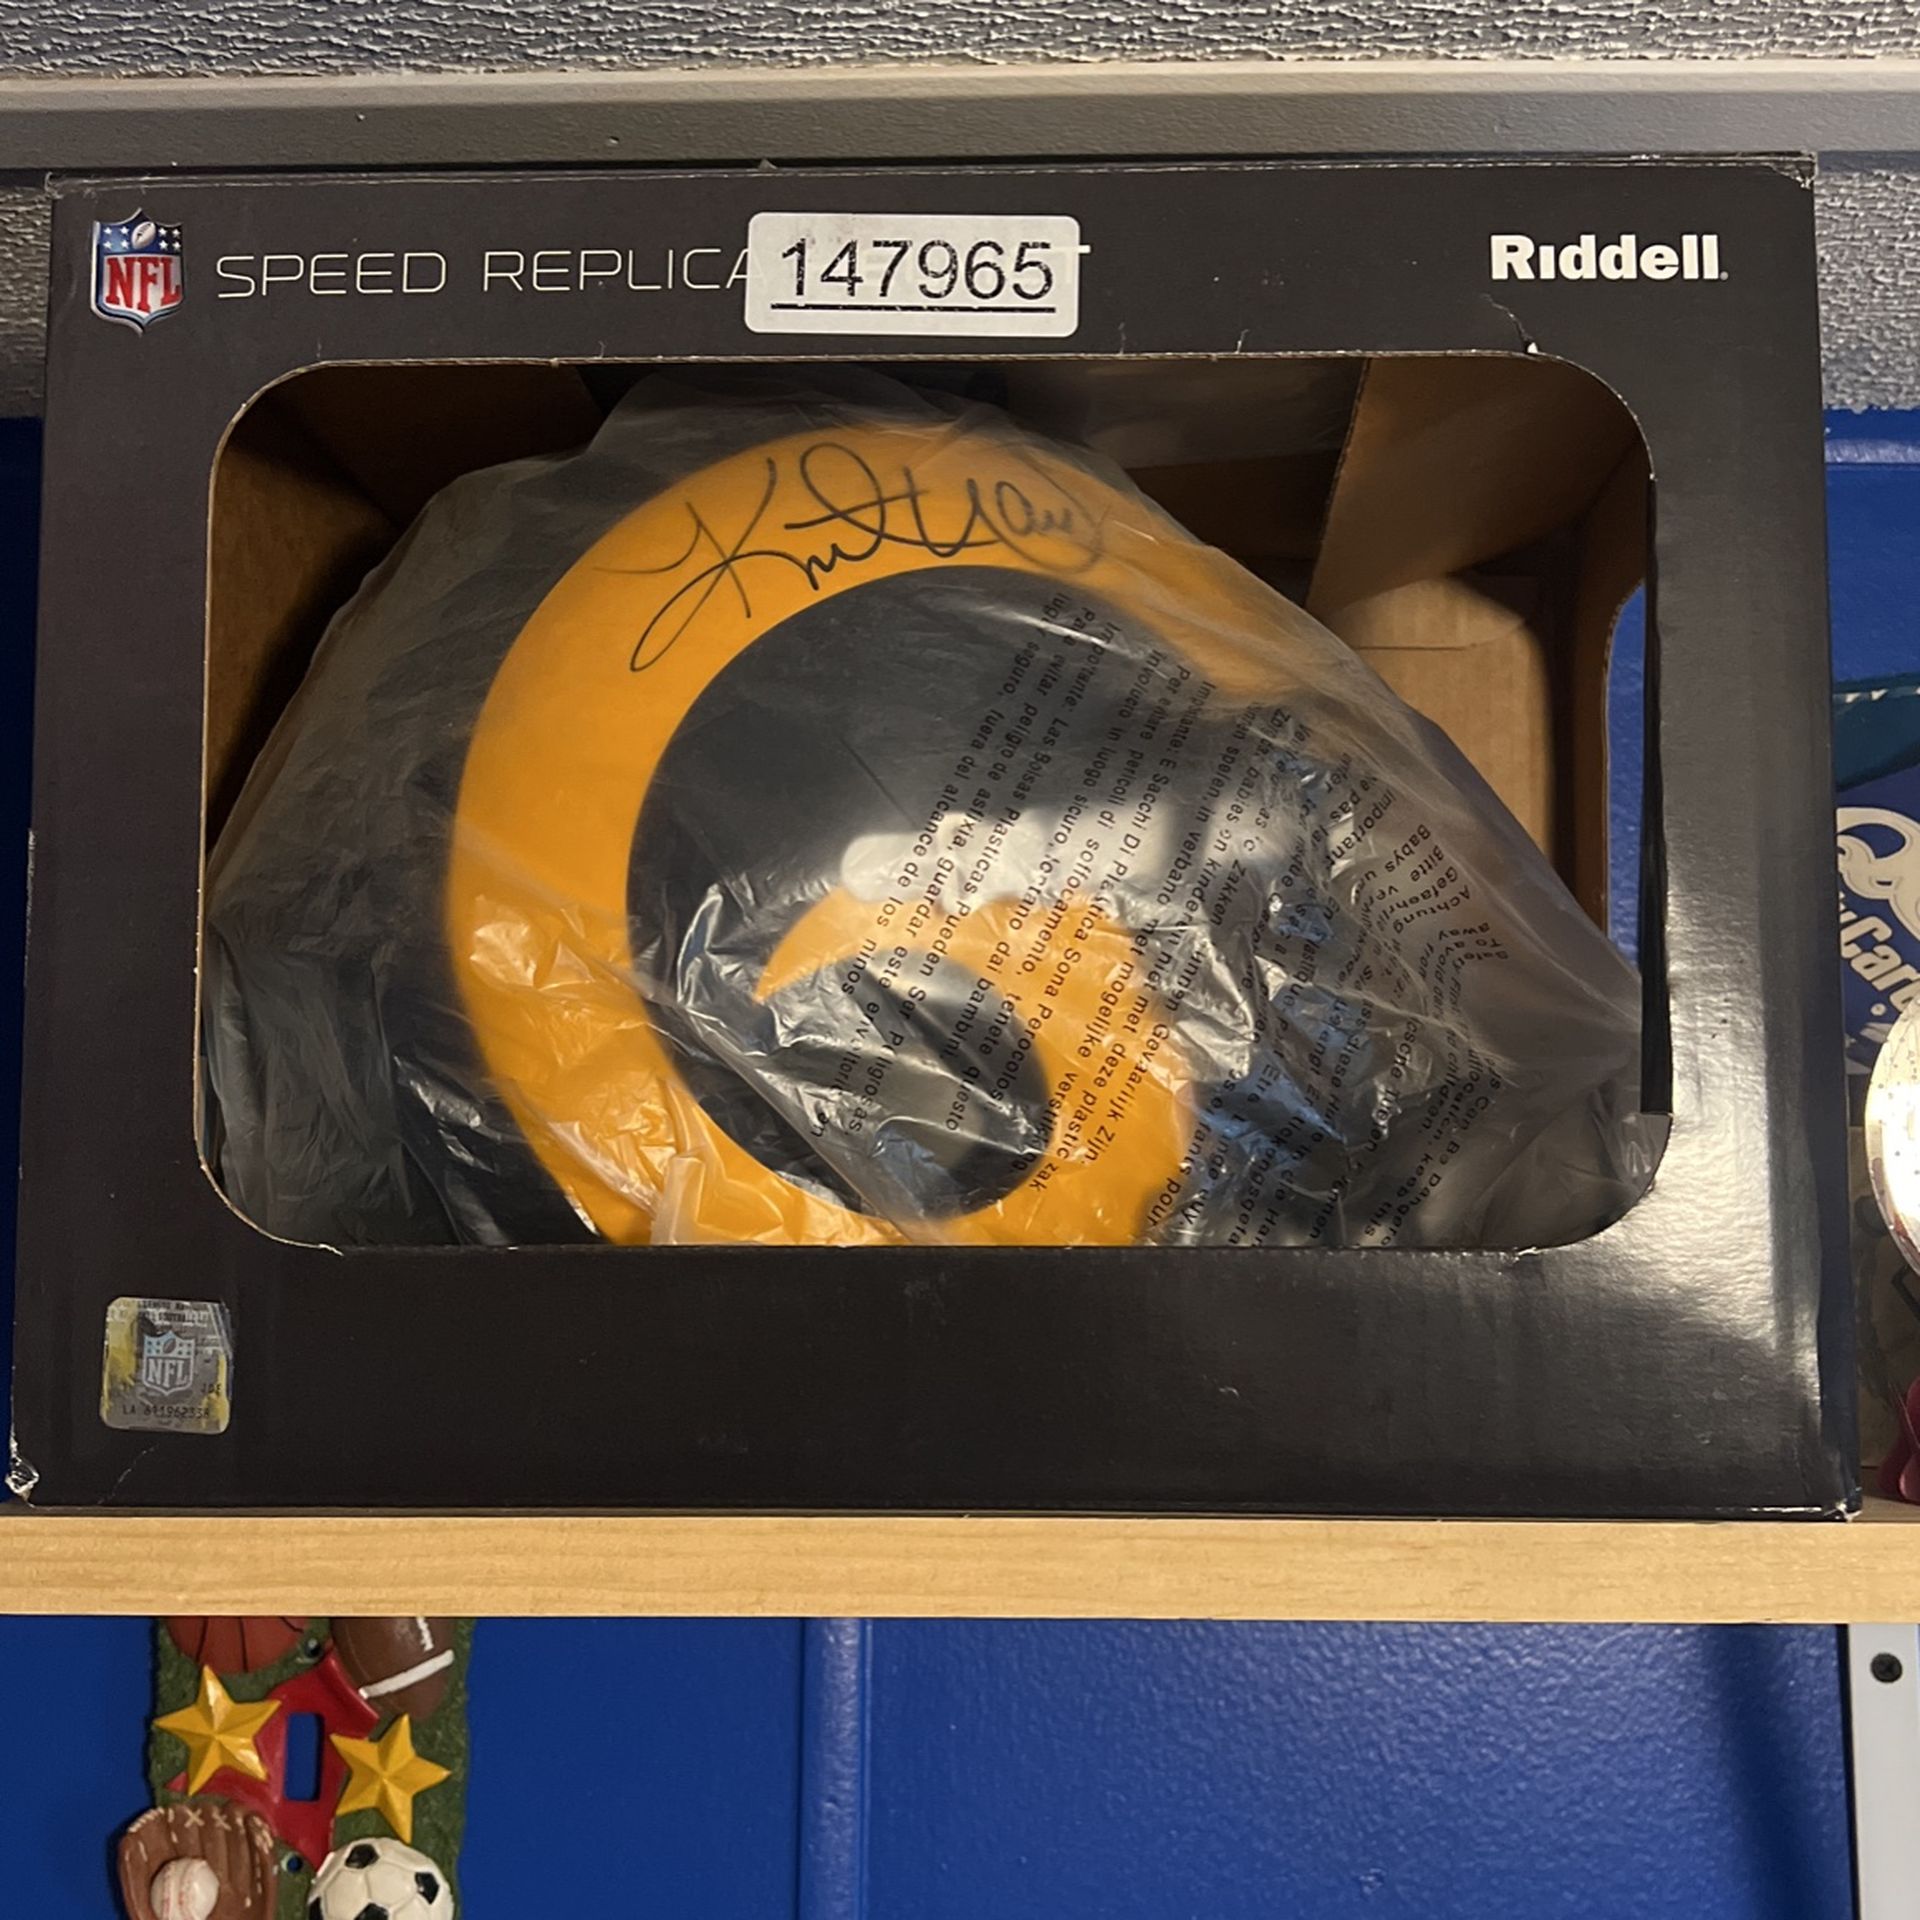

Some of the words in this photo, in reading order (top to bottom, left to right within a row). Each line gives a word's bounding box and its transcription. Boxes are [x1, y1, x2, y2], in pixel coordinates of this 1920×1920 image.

[104, 256, 182, 311] NFL
[216, 251, 447, 299] SPEED
[780, 238, 1056, 300] 147965
[996, 637, 1041, 702] seguro,
[1163, 664, 1191, 696] Per
[969, 707, 1006, 754] fuera
[996, 701, 1040, 761] peligro
[1040, 716, 1069, 748] Las
[952, 753, 979, 781] del
[986, 759, 1008, 783] de
[1010, 750, 1052, 803] Bolsas
[1079, 743, 1116, 791] luogo
[1158, 755, 1177, 772] E
[911, 782, 962, 860] alcance
[1047, 791, 1091, 853] sicuro,
[1095, 809, 1118, 831] di
[1128, 771, 1171, 831] Sacchi
[1194, 806, 1215, 826] in
[1328, 788, 1362, 823] pas
[961, 804, 1021, 897] Plasticas
[1117, 832, 1141, 857] Di
[1381, 821, 1432, 875] Babys
[1407, 843, 1446, 884] Bitte
[895, 859, 923, 891] de
[902, 855, 957, 940] guardar
[1206, 858, 1249, 928] Zakken
[874, 895, 904, 931] los
[1014, 837, 1104, 983] soffocamento,
[1391, 883, 1469, 935] Achtung
[917, 899, 972, 980] Pueden
[985, 939, 1014, 975] dai
[838, 937, 881, 998] ninos
[875, 943, 910, 991] este
[1042, 945, 1083, 1001] Sona
[1142, 949, 1175, 994] niet
[1162, 937, 1214, 1014] unnen
[976, 990, 1023, 1059] tenete
[1071, 958, 1139, 1062] mogelijke
[1121, 994, 1152, 1035] met
[1090, 1039, 1131, 1092] deze
[1052, 1089, 1101, 1163] plastic
[1456, 1093, 1492, 1133] Can
[1076, 1121, 1117, 1172] Zijn.
[1027, 1161, 1060, 1195] zak
[1143, 1177, 1183, 1228] pour
[1249, 1207, 1281, 1253] Han
[1361, 1199, 1394, 1238] this
[1379, 1171, 1442, 1248] Dangero
[147, 1357, 189, 1388] NFL
